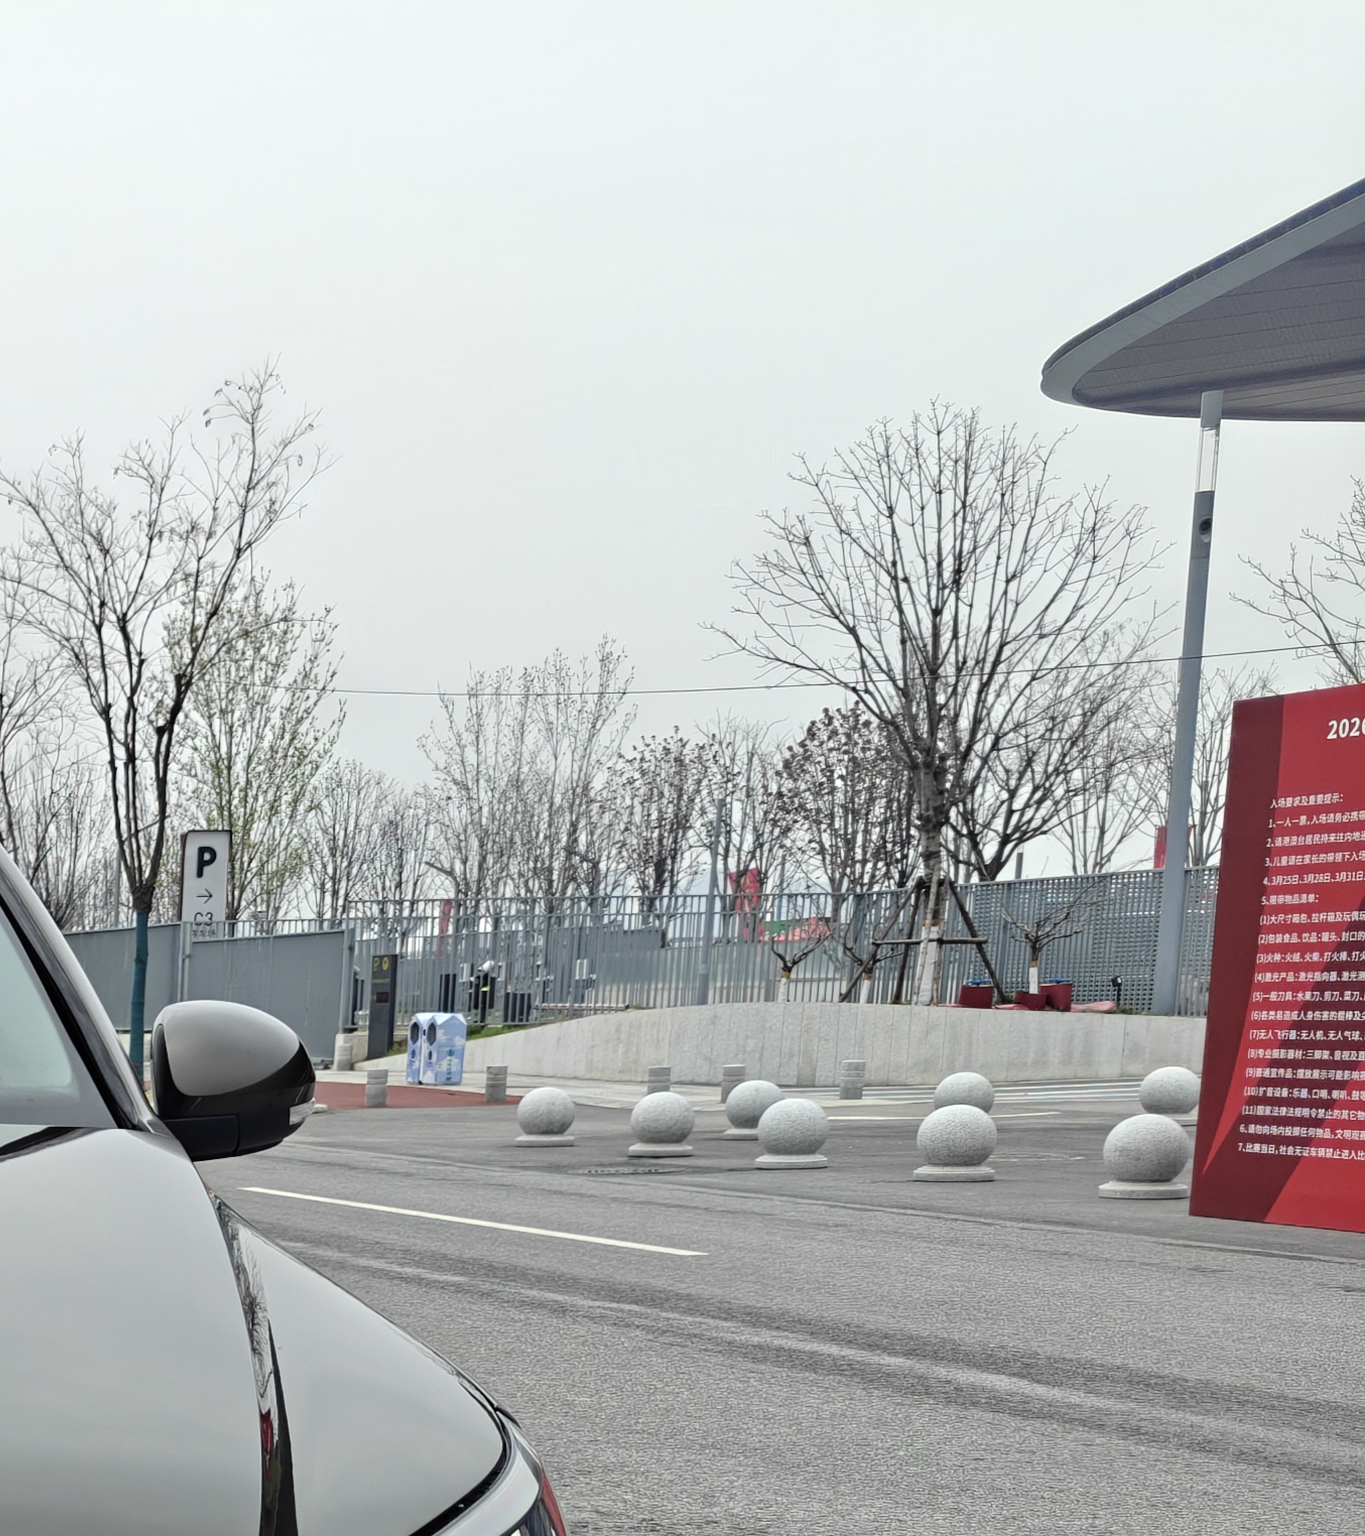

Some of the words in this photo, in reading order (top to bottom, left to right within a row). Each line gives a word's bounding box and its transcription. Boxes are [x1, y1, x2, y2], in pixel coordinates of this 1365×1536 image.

[196, 846, 217, 878] P
[194, 912, 213, 926] C3
[1252, 991, 1365, 1003] (5)一般刀具：水果刀、剪刀、菜刀、
[1249, 1030, 1365, 1042] (7)无人飞行器：无人机、无人气球、
